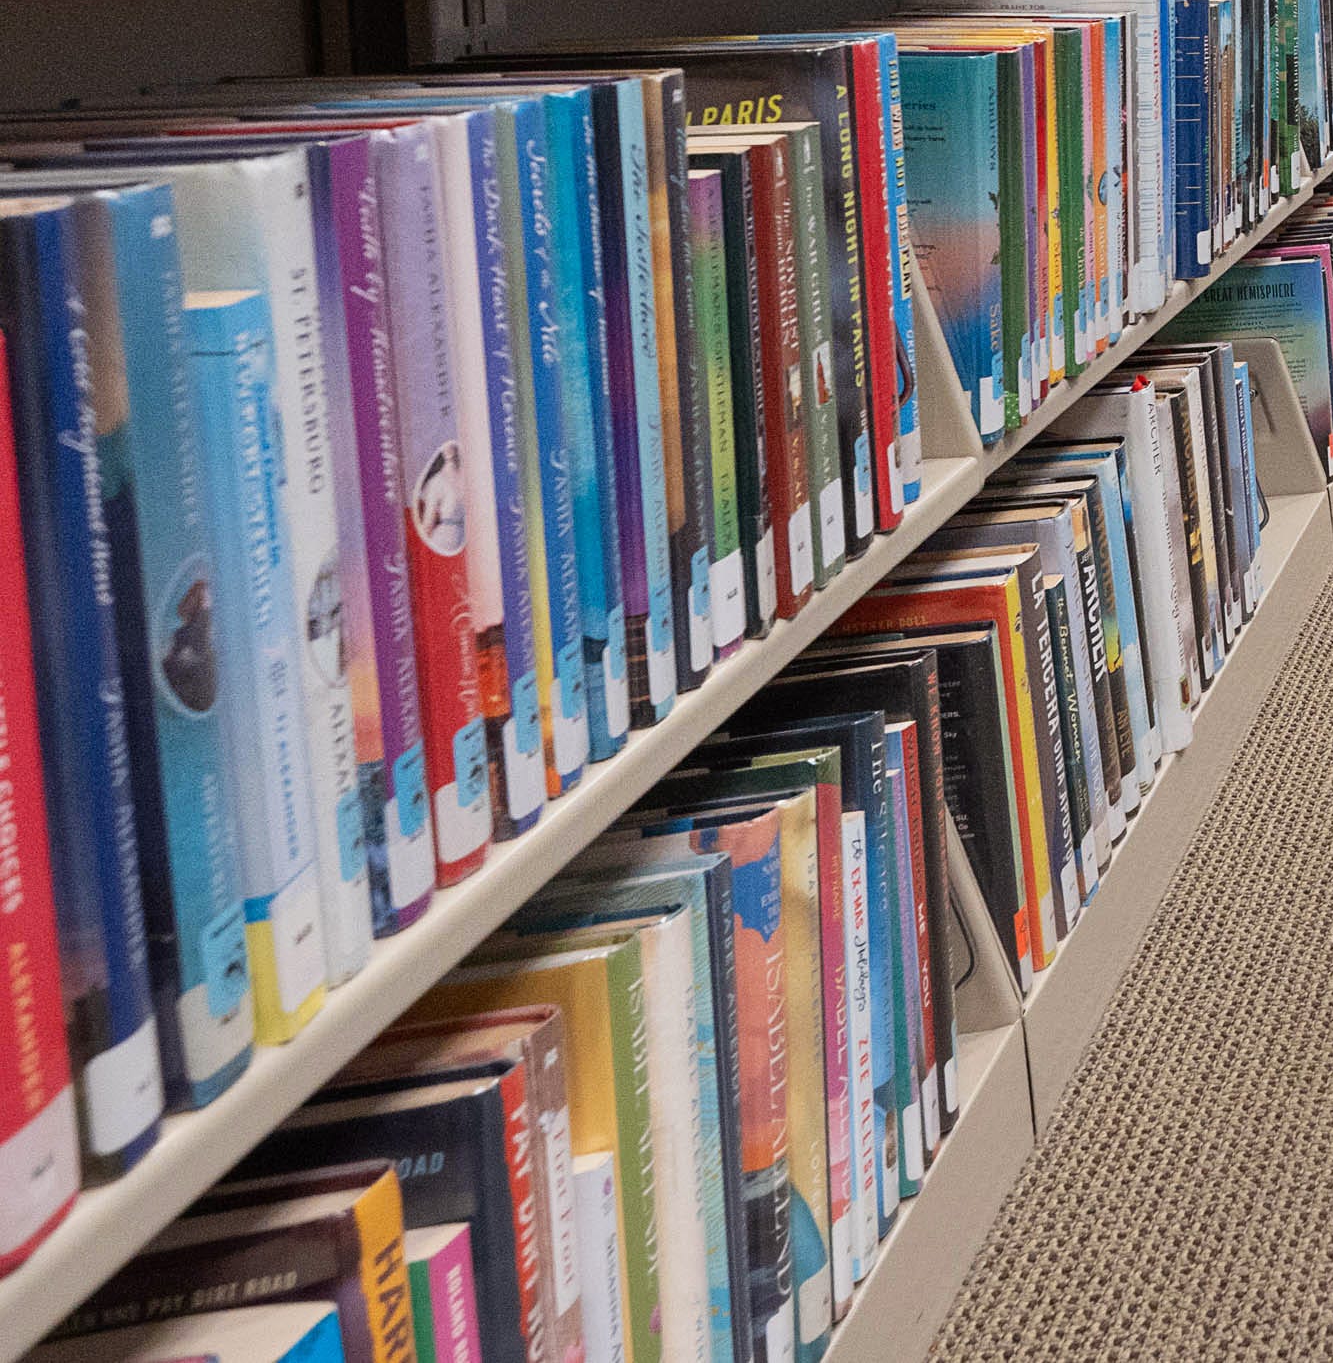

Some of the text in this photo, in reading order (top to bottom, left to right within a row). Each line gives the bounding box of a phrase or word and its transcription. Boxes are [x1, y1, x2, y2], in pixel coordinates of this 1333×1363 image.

[701, 94, 784, 126] PARIS
[836, 112, 865, 389] LONG NIGHT IN PARIS
[1237, 283, 1296, 301] HEMISPHERE
[1145, 401, 1163, 479] ARCHER
[1032, 571, 1060, 741] LA TERCERA
[1082, 553, 1108, 685] ARCHER
[1058, 625, 1082, 764] Bennet Women
[766, 948, 787, 1109] ISABEL
[918, 962, 933, 1008] YOU
